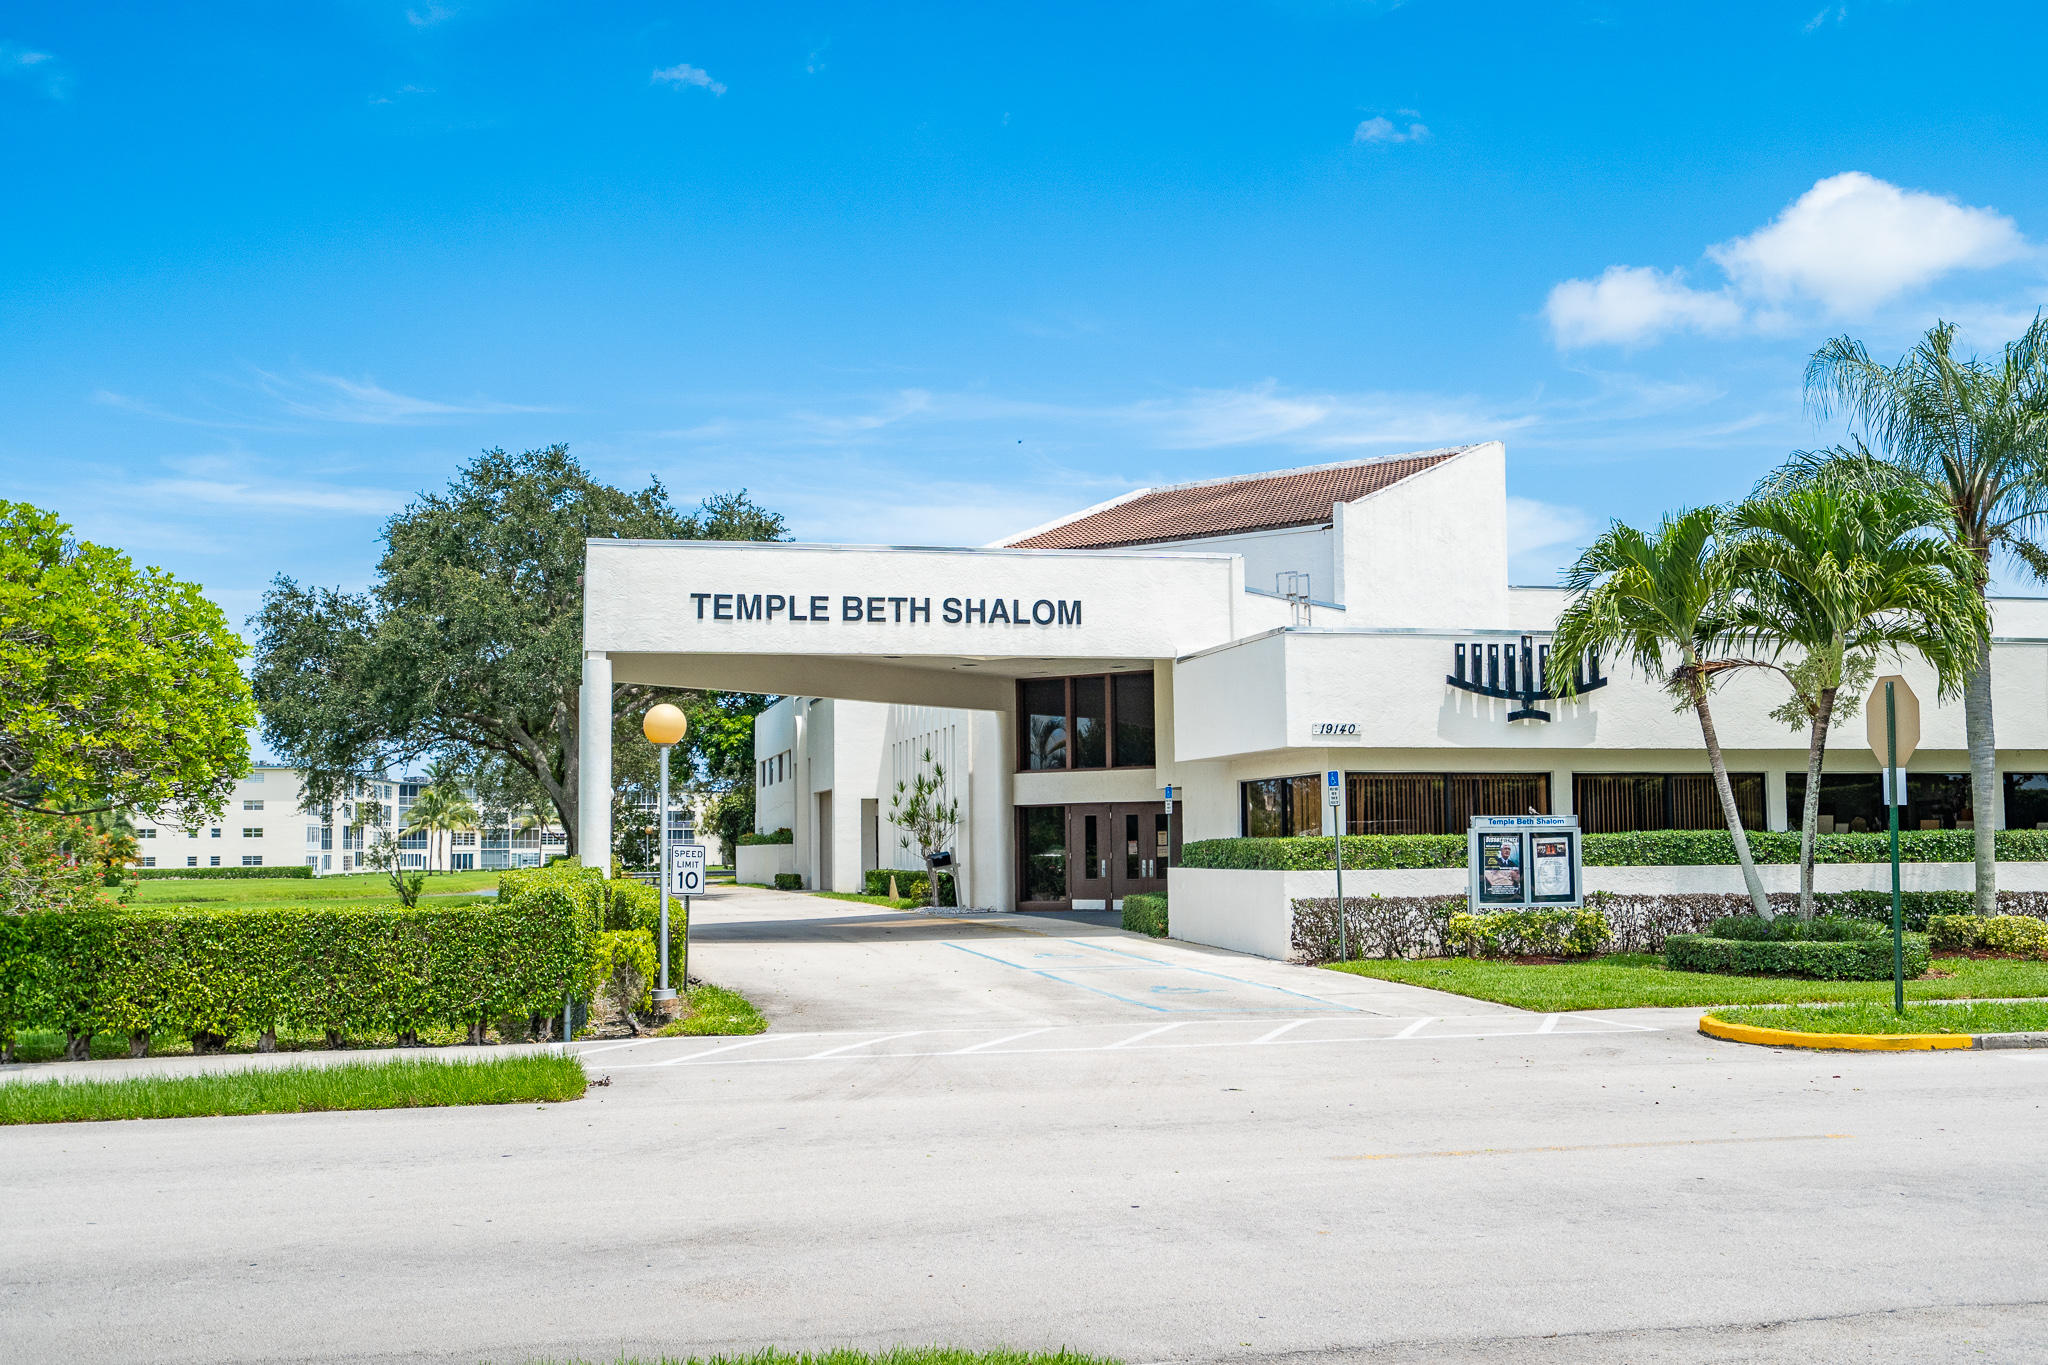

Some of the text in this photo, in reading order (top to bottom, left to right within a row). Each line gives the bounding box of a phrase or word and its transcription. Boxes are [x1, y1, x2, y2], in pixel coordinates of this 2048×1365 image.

[690, 593, 1082, 625] TEMPLE BETH SHALOM
[1320, 723, 1356, 734] 19140
[1488, 818, 1514, 826] Temple
[678, 871, 698, 889] 10
